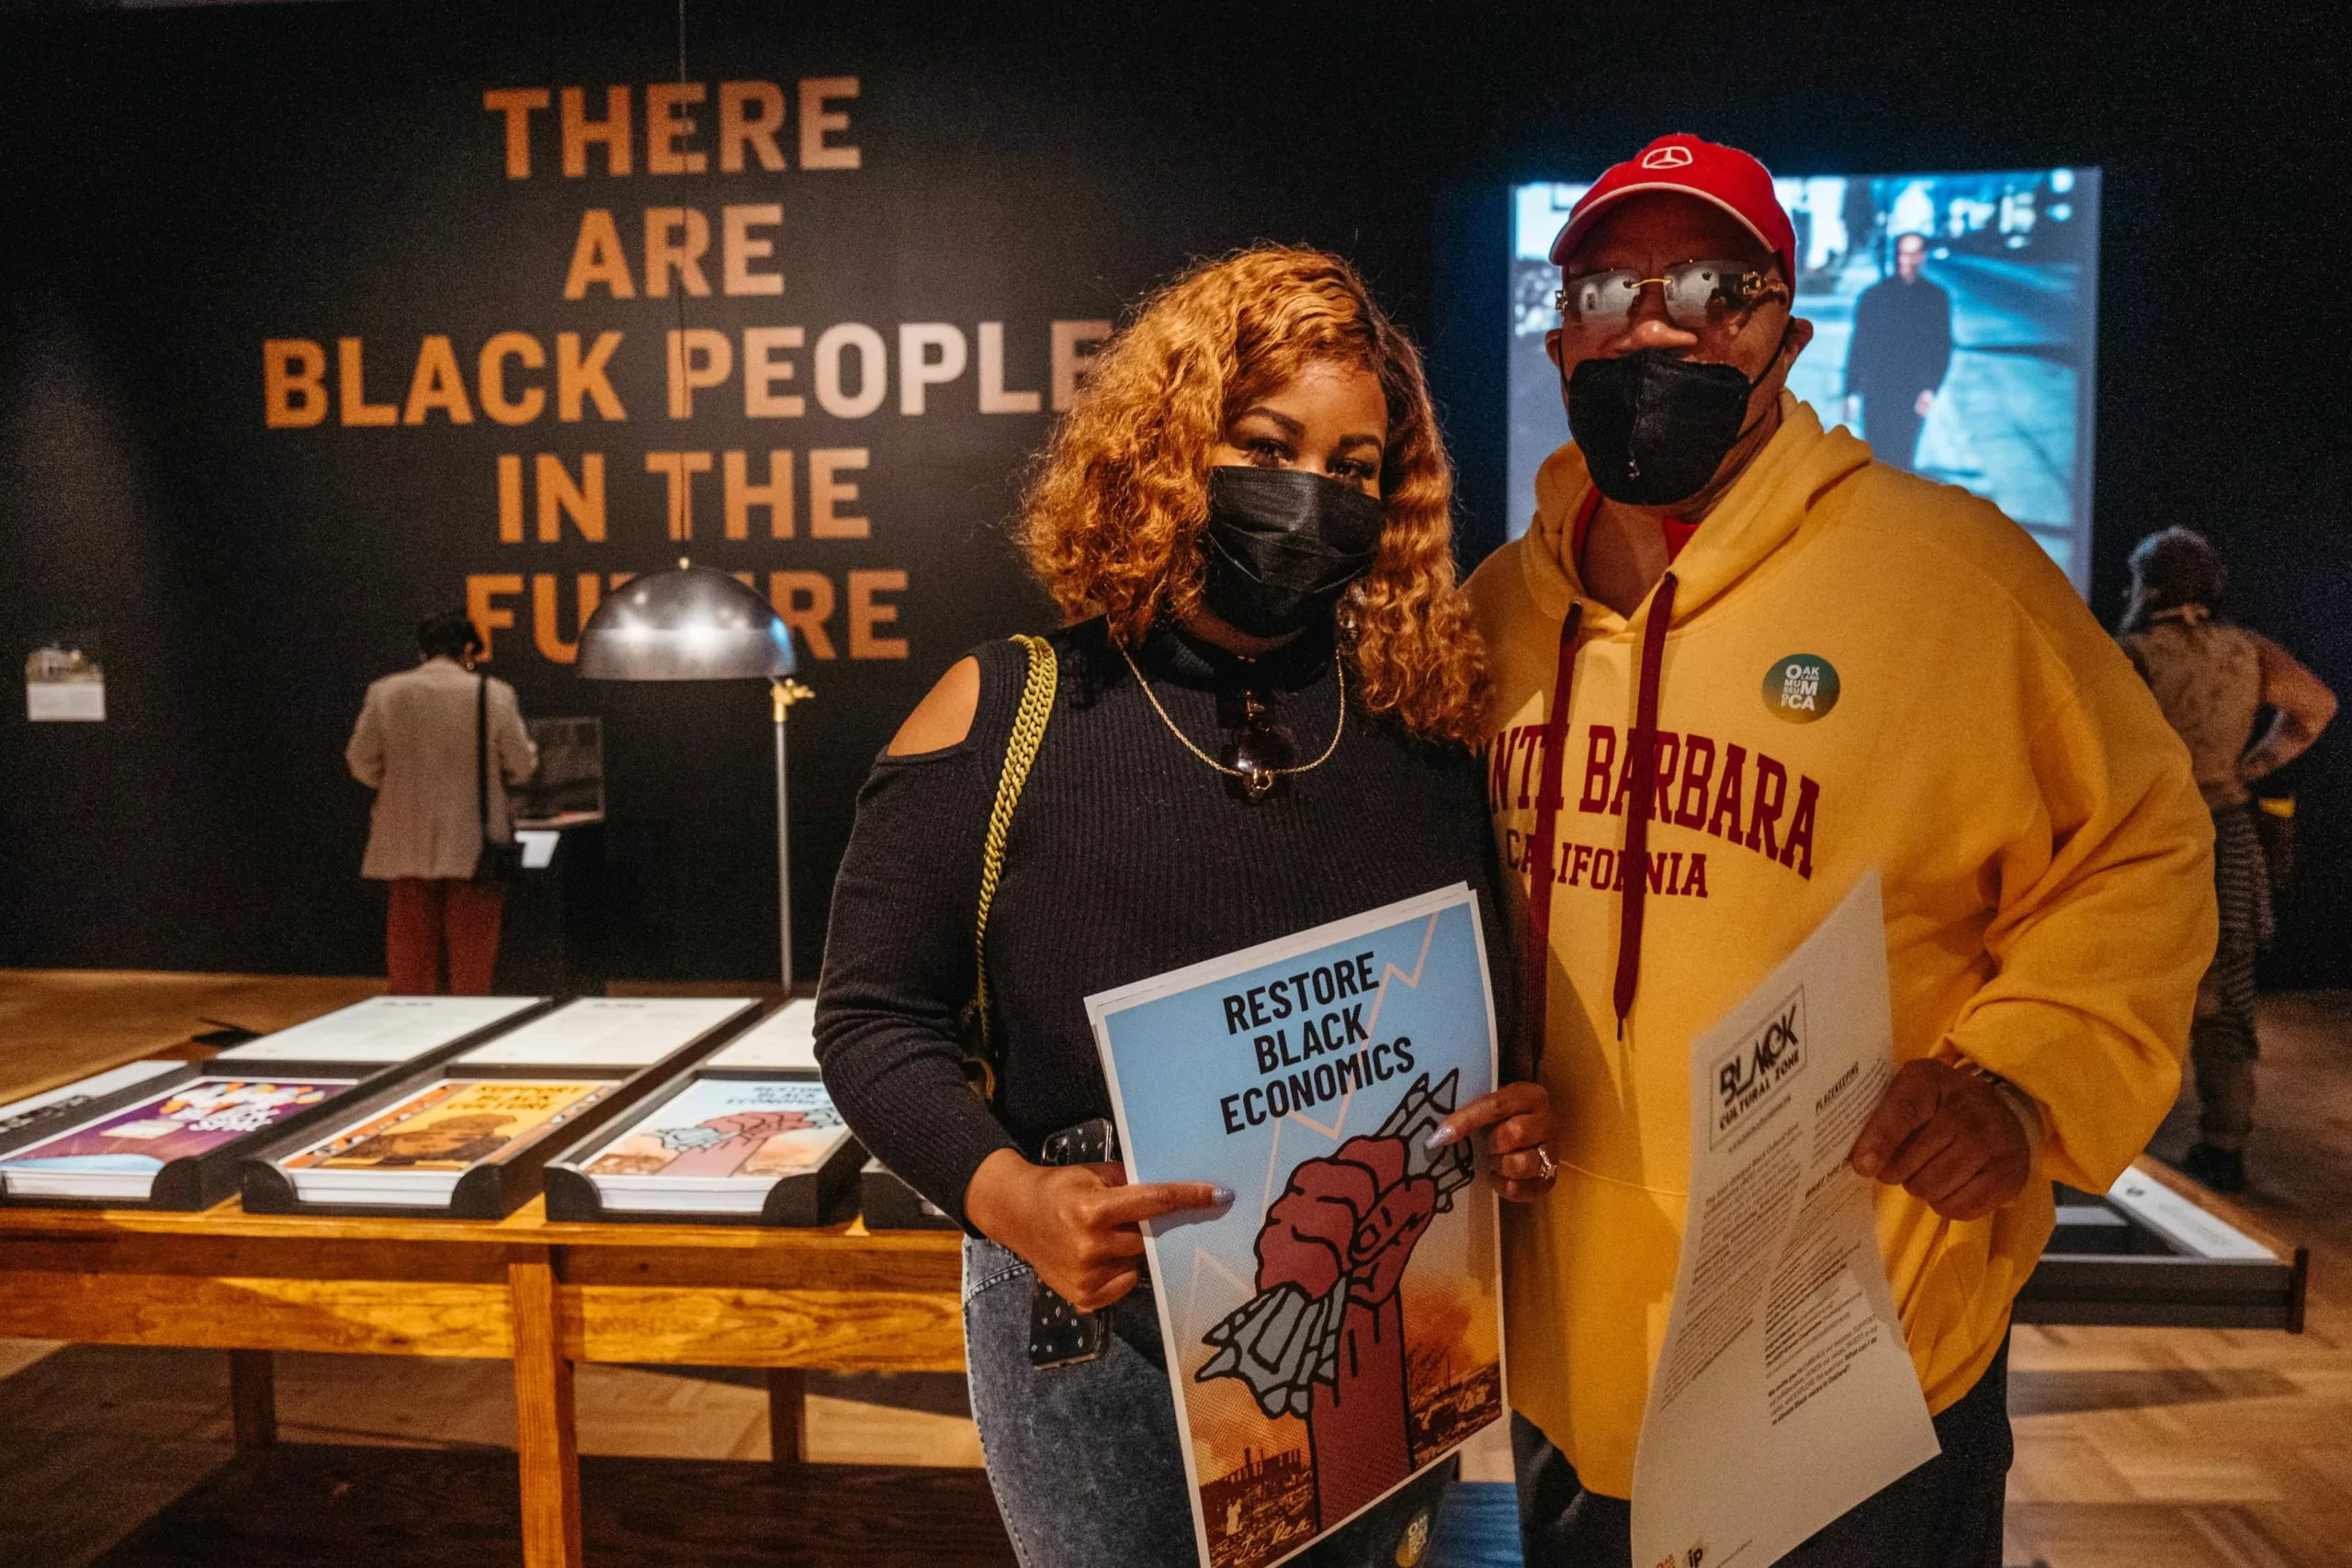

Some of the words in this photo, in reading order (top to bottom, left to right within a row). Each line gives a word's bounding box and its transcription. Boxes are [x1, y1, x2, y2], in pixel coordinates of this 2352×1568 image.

[483, 76, 862, 179] THERE
[563, 204, 785, 300] ARE
[264, 332, 627, 428] BLACK
[665, 321, 1113, 421] PEOPLE
[496, 454, 606, 544] IN
[645, 448, 871, 542] THE
[466, 570, 910, 665] FURE
[1579, 725, 1820, 881] BARBARA
[1506, 829, 1708, 897] CAIFONIA
[1222, 952, 1379, 1035] RESTORE
[1253, 1004, 1369, 1075] BLACK
[1220, 1036, 1415, 1135] ECONOMICS
[1719, 1003, 1799, 1108] BLACK
[1719, 1077, 1771, 1131] CULTURAL
[1774, 1048, 1800, 1081] ZONE
